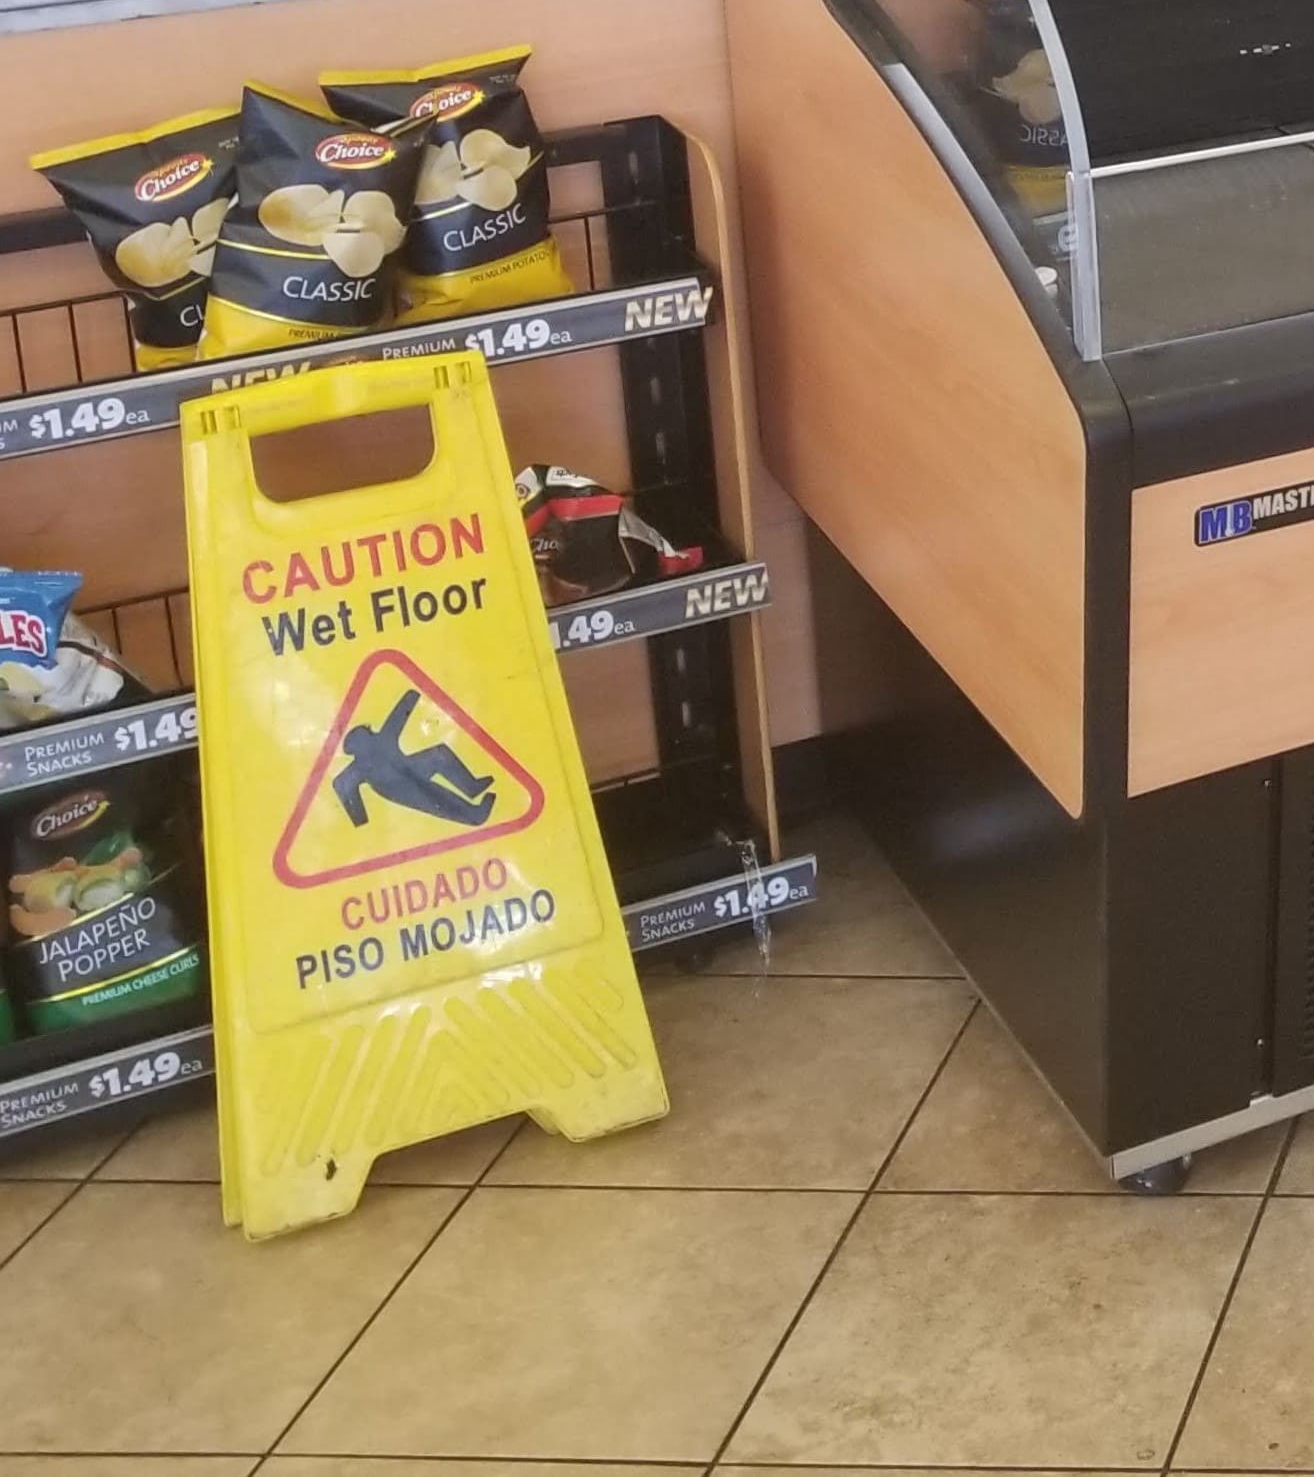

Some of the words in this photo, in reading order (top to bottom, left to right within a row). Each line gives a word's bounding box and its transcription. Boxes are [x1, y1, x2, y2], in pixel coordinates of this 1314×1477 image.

[319, 142, 384, 163] Choice
[139, 158, 200, 202] Choice
[443, 203, 527, 253] CLASSIC
[283, 276, 376, 302] CLASSIC
[382, 338, 456, 362] PREMIUM
[624, 285, 713, 332] NEW
[242, 513, 485, 604] CAUTION
[261, 601, 357, 656] Wet
[371, 577, 486, 633] Floor
[685, 572, 770, 619] NEW
[24, 732, 104, 762] PREMIUM
[27, 751, 92, 778] SNACKS
[37, 794, 99, 837] Choice
[341, 857, 507, 931] CUIDADO
[640, 901, 706, 928] PREMIUM
[40, 897, 156, 965] JALAPEÑO
[296, 937, 385, 990] PISO
[400, 889, 556, 962] MOJADO
[641, 918, 695, 943] SNACKS
[58, 928, 151, 982] POPPER
[81, 983, 133, 1007] PREMIUM
[133, 970, 170, 992] CHEESE
[170, 954, 200, 976] CURLS
[0, 1082, 79, 1113] PREMIUM
[0, 1101, 67, 1128] SNACKS
